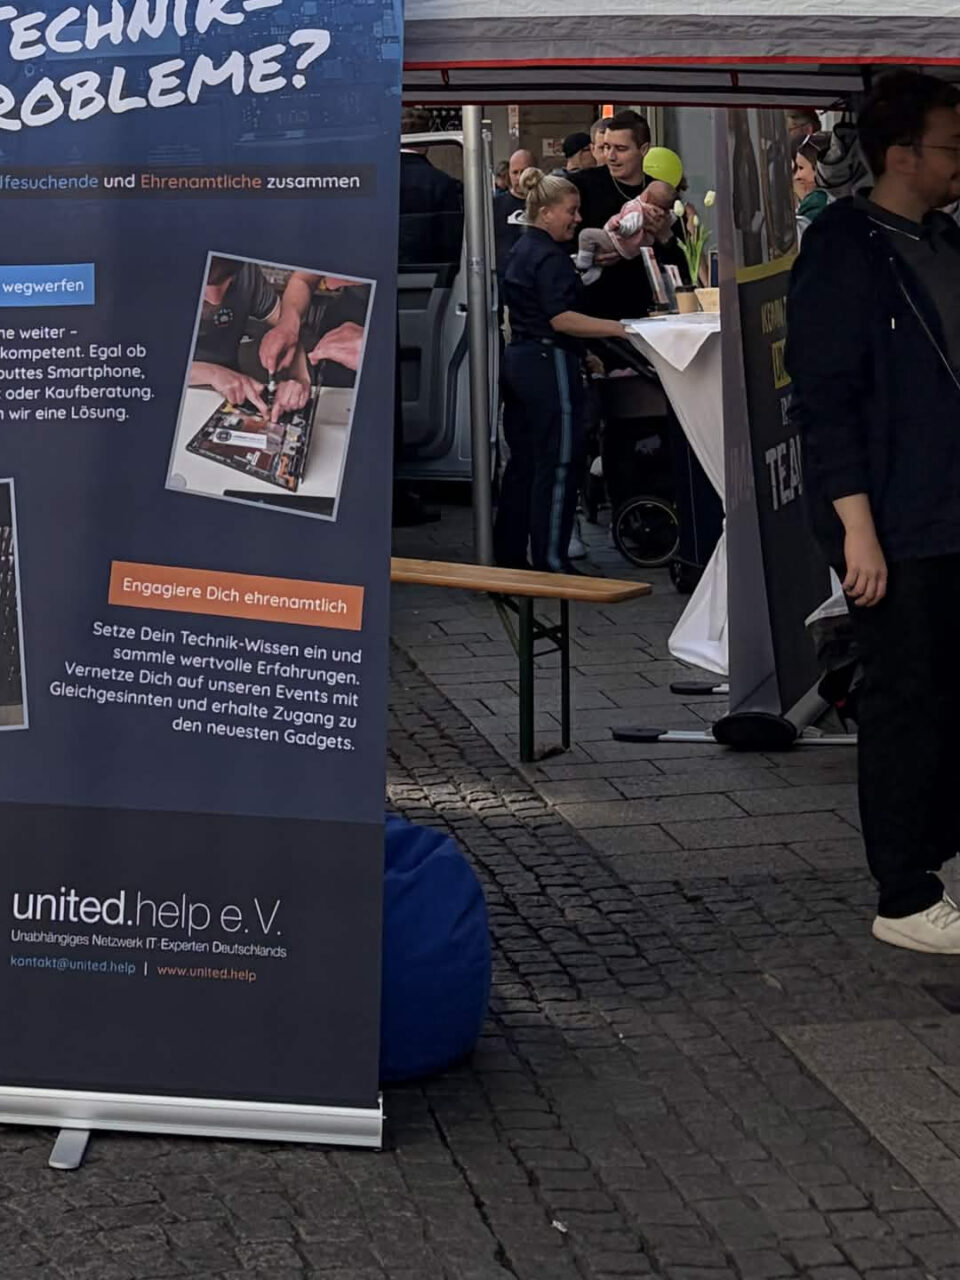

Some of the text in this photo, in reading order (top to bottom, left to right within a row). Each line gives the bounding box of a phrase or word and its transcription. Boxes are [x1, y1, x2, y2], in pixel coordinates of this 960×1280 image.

[104, 174, 135, 188] und
[141, 174, 261, 188] Ehrenamtliche
[267, 176, 359, 188] zusammen
[3, 279, 84, 295] wegwerfen
[20, 327, 65, 339] weiter
[0, 347, 84, 361] kompetent.
[90, 344, 121, 360] Egal
[127, 344, 146, 357] ob
[48, 365, 144, 380] Smartphone,
[6, 387, 40, 400] oder
[46, 385, 154, 401] Kaufberatung.
[9, 408, 31, 419] wir
[36, 408, 66, 419] eine
[72, 406, 128, 421] Lösung.
[124, 578, 346, 613] Engagiere Dich ehrenamtlich
[93, 622, 361, 663] Setze Dein Technik-Wissen ein und
[114, 648, 359, 685] sammle wertvolle Erfahrungen.
[65, 662, 358, 706] Vernetze Dich auf unseren Events mit
[50, 678, 356, 729] Gleichgesinnten und erhalte Zugang zu
[173, 717, 354, 750] den neuesten Gadgets.
[12, 886, 210, 937] united.help
[12, 930, 89, 947] Unabhängiges
[92, 934, 143, 947] Netzwerk
[212, 941, 286, 957] Deutschlands
[11, 956, 256, 982] kontakt@united.help www.united.help
